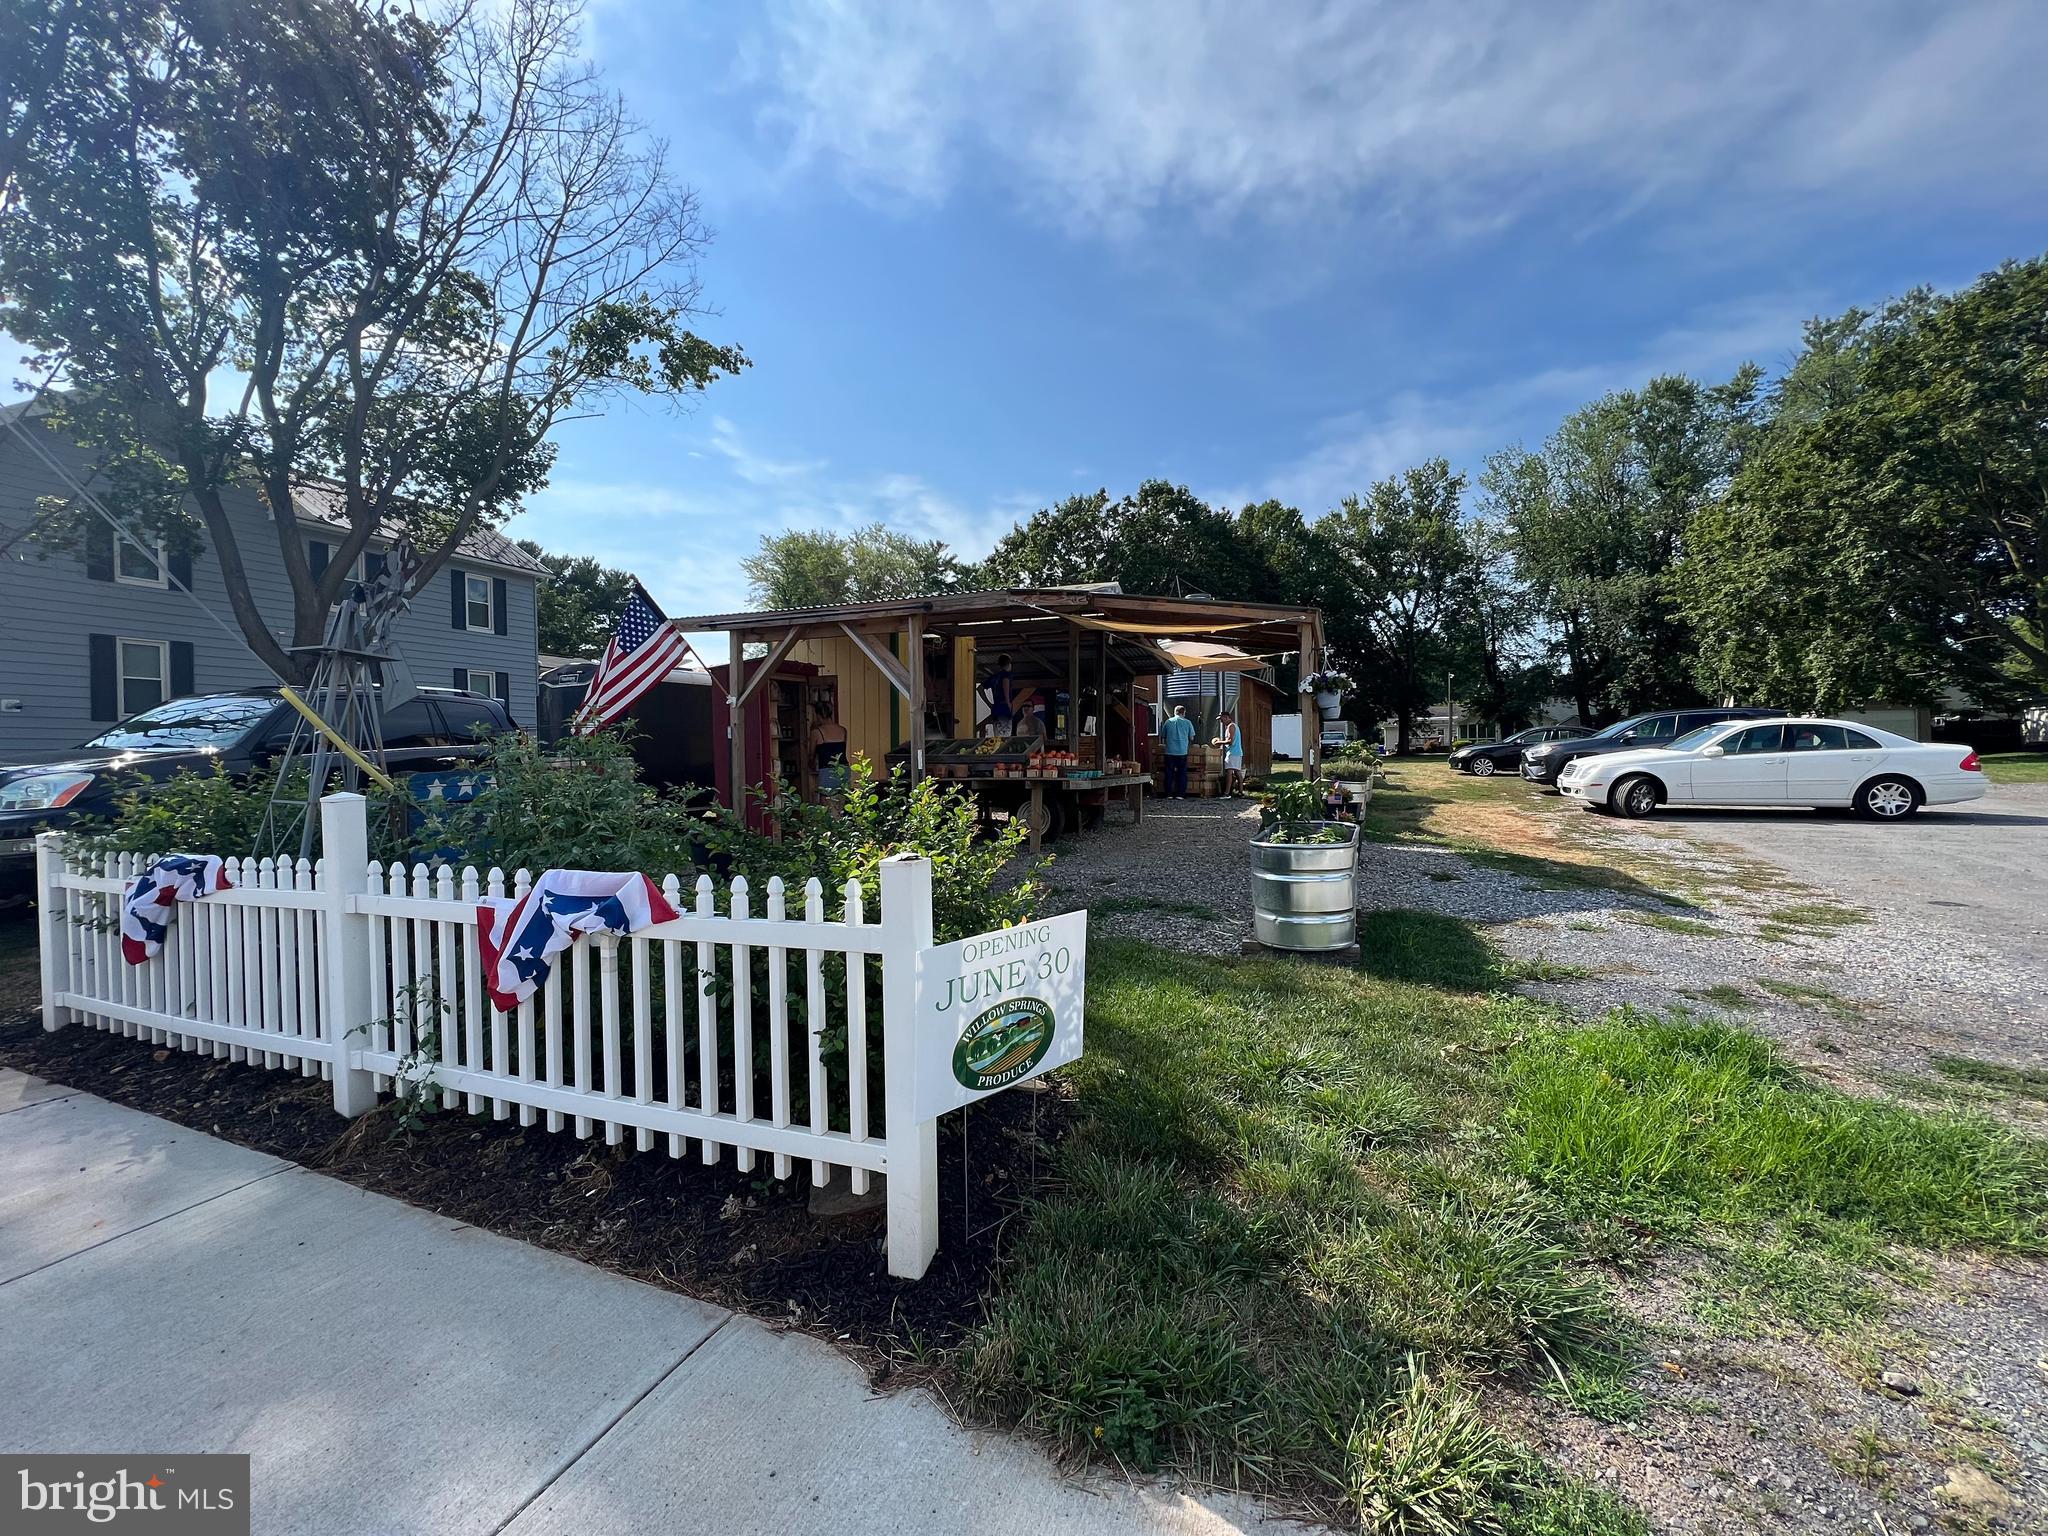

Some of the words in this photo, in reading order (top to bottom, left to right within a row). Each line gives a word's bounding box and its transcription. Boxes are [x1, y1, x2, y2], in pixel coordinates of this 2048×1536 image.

[962, 925, 1050, 963] OPENING
[935, 959, 1027, 1012] JUNE
[1037, 947, 1070, 980] 30
[962, 1004, 1006, 1043] WILLOW
[1008, 1000, 1048, 1016] SPRINGS
[977, 1057, 1034, 1087] PRODUCE
